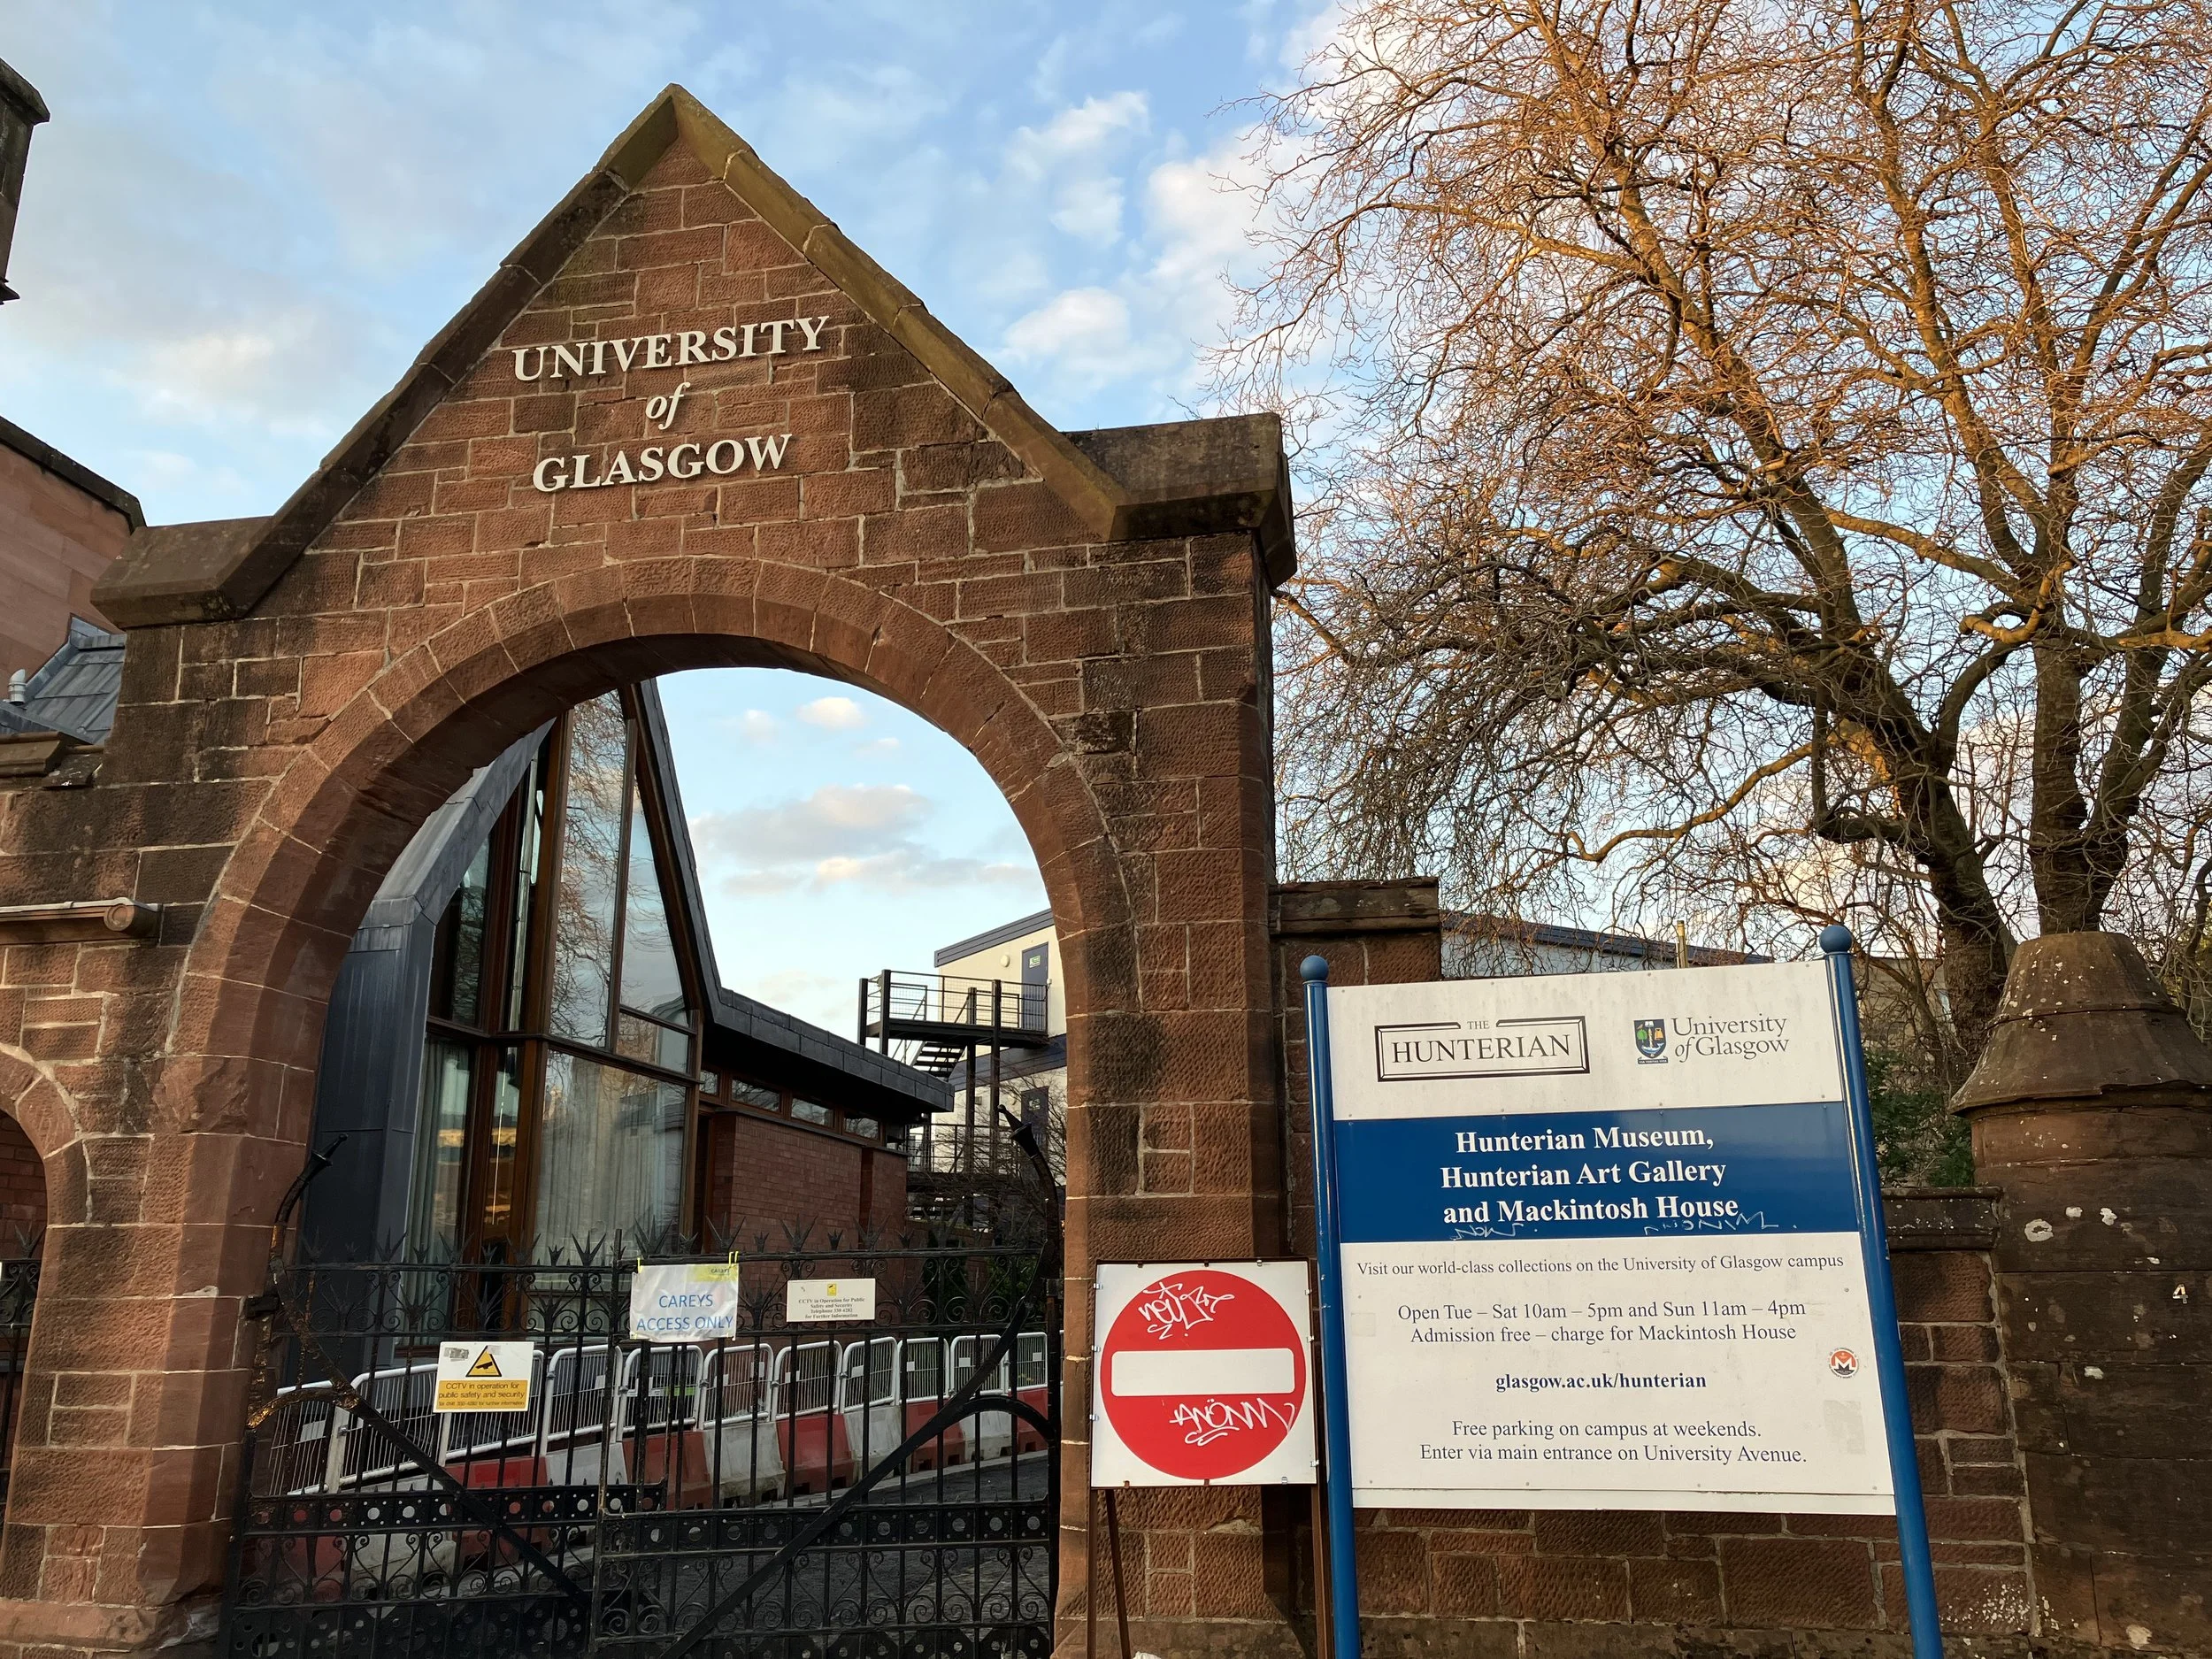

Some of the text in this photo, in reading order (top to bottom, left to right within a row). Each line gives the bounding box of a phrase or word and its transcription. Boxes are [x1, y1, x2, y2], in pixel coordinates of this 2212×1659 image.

[511, 315, 830, 381] UNIVERSITY
[645, 381, 690, 430] of
[533, 434, 793, 493] GLASGOW
[1467, 1020, 1490, 1030] THE
[1671, 1013, 1787, 1037] University
[1392, 1034, 1570, 1064] HUNTERIAN
[1675, 1035, 1789, 1063] of Glasgow
[1455, 1127, 1714, 1153] Hunterian Museum,
[1440, 1160, 1727, 1187] Hunterian Art Gallery
[1444, 1196, 1739, 1223] and Mackintosh House
[1357, 1256, 1844, 1275] Visit our world-class collections on the University of Glasgow campus
[659, 1294, 713, 1308] CAREYS
[2172, 1283, 2189, 1304] 4
[637, 1316, 733, 1331] ACCESS ONLY
[1399, 1305, 1440, 1325] Open
[1444, 1304, 1472, 1319] Tue
[1493, 1303, 1517, 1319] Sat
[1525, 1303, 1568, 1318] 10am
[1588, 1302, 1624, 1322] 5pm
[1629, 1301, 1658, 1317] and
[1663, 1301, 1695, 1317] Sun
[1703, 1301, 1747, 1317] 11am
[1768, 1300, 1806, 1319] 4pm
[1411, 1327, 1495, 1343] Admission
[1501, 1326, 1532, 1342] free
[1552, 1325, 1605, 1346] charge
[1610, 1325, 1634, 1341] for
[1640, 1324, 1737, 1340] Mackintosh
[1742, 1324, 1797, 1340] House
[1496, 1373, 1707, 1393] glasgow.ac.uk/hunterian
[1453, 1420, 1762, 1440] Free parking on campus at weekends.
[1421, 1444, 1807, 1466] Enter via main entrance on University Avenue.
